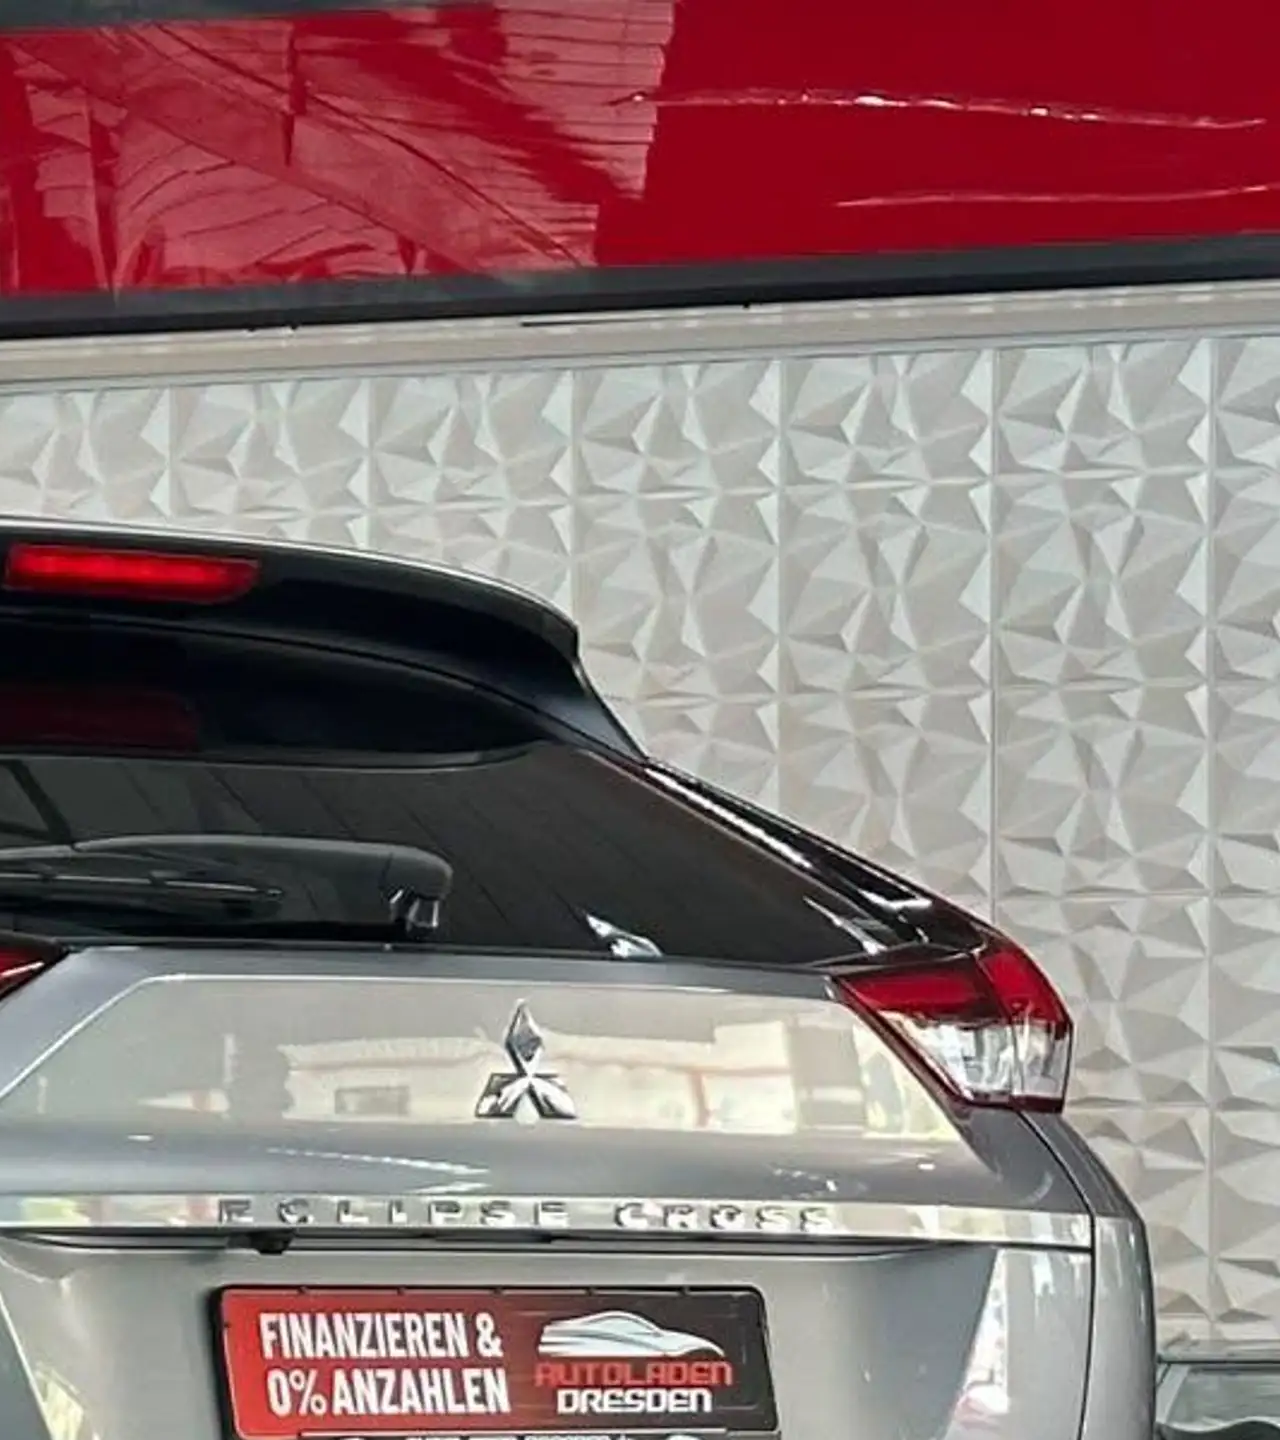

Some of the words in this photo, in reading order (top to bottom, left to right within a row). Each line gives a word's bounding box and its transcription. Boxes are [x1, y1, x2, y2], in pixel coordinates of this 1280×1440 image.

[218, 1199, 569, 1228] ECLIPSE
[614, 1201, 838, 1235] CROSS
[259, 1312, 470, 1360] FINANZIEREN
[475, 1312, 504, 1357] &
[266, 1368, 328, 1417] 0%
[332, 1367, 511, 1416] ANZAHLEN
[535, 1361, 733, 1387] AUTOLADEN
[557, 1388, 713, 1413] DRESDEN
